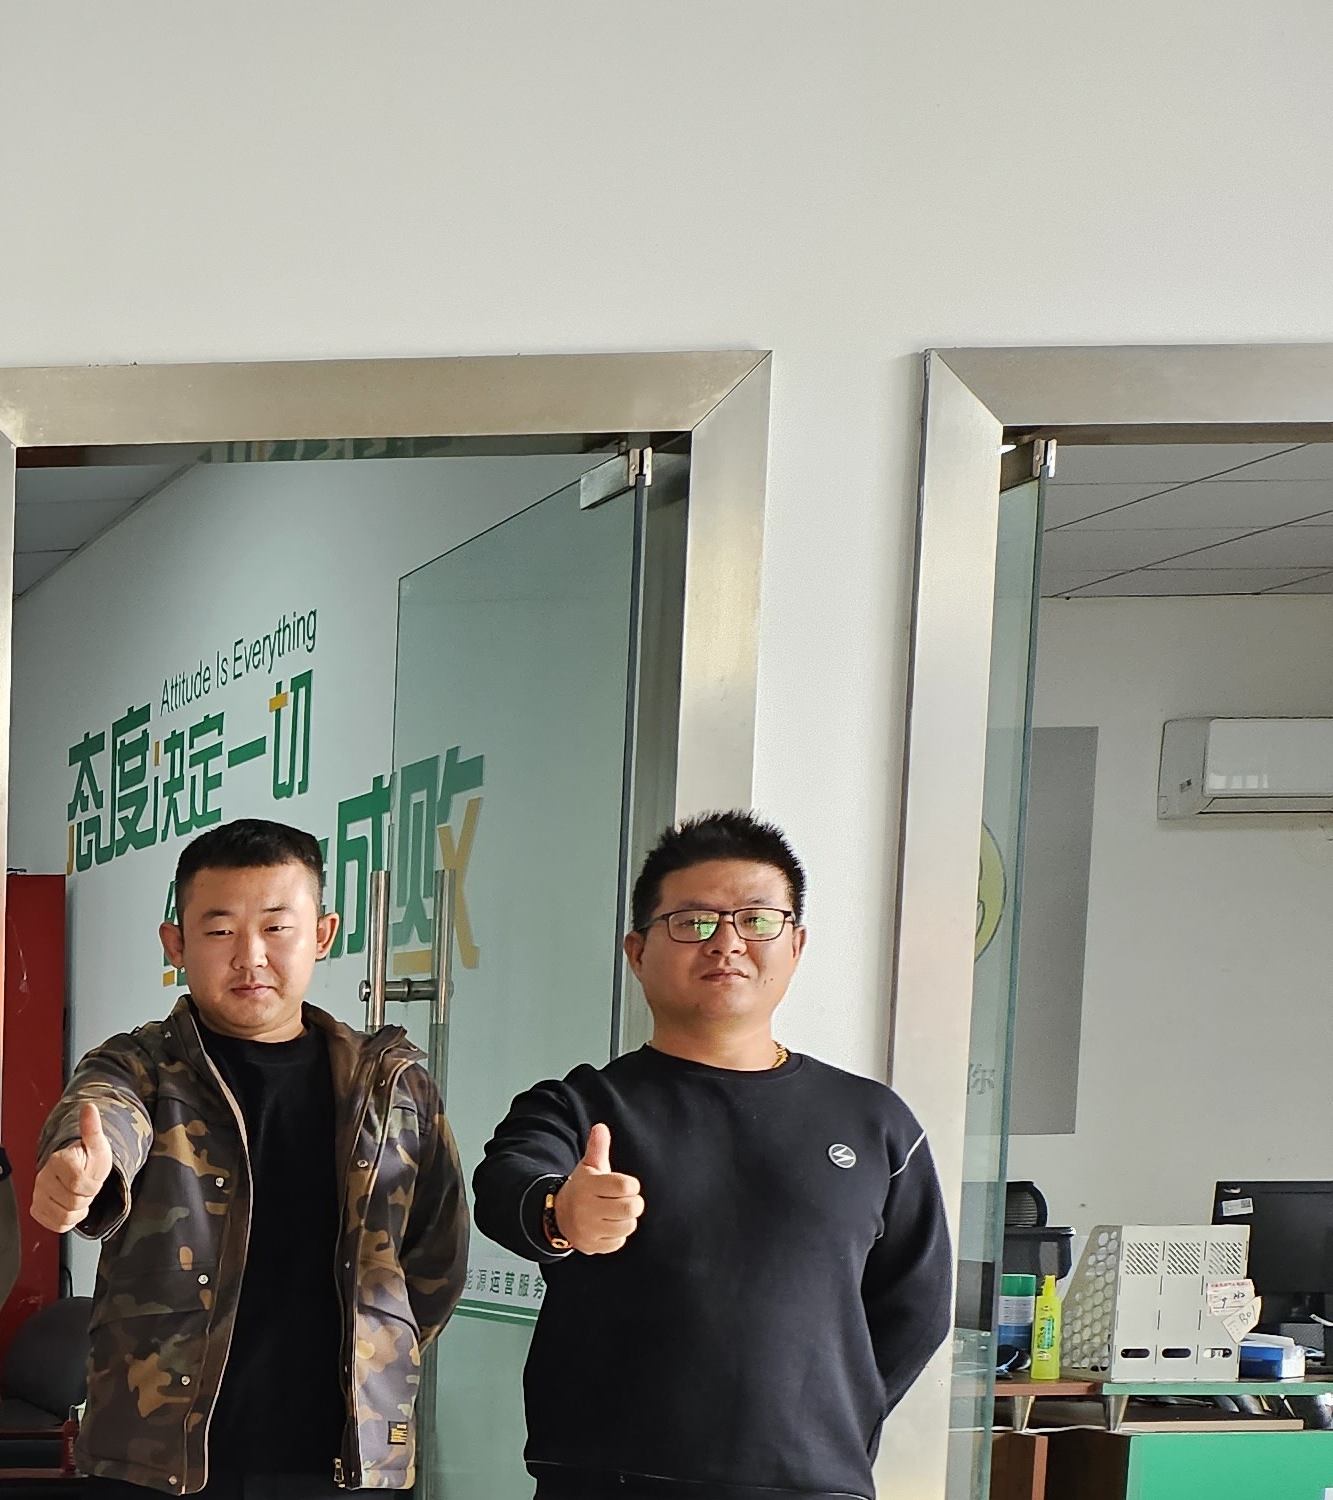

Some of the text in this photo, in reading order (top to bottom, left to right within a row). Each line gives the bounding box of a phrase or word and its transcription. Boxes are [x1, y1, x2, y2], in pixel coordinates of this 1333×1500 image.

[160, 608, 317, 717] Attitude Is Everything
[66, 669, 314, 875] 态度决定一切
